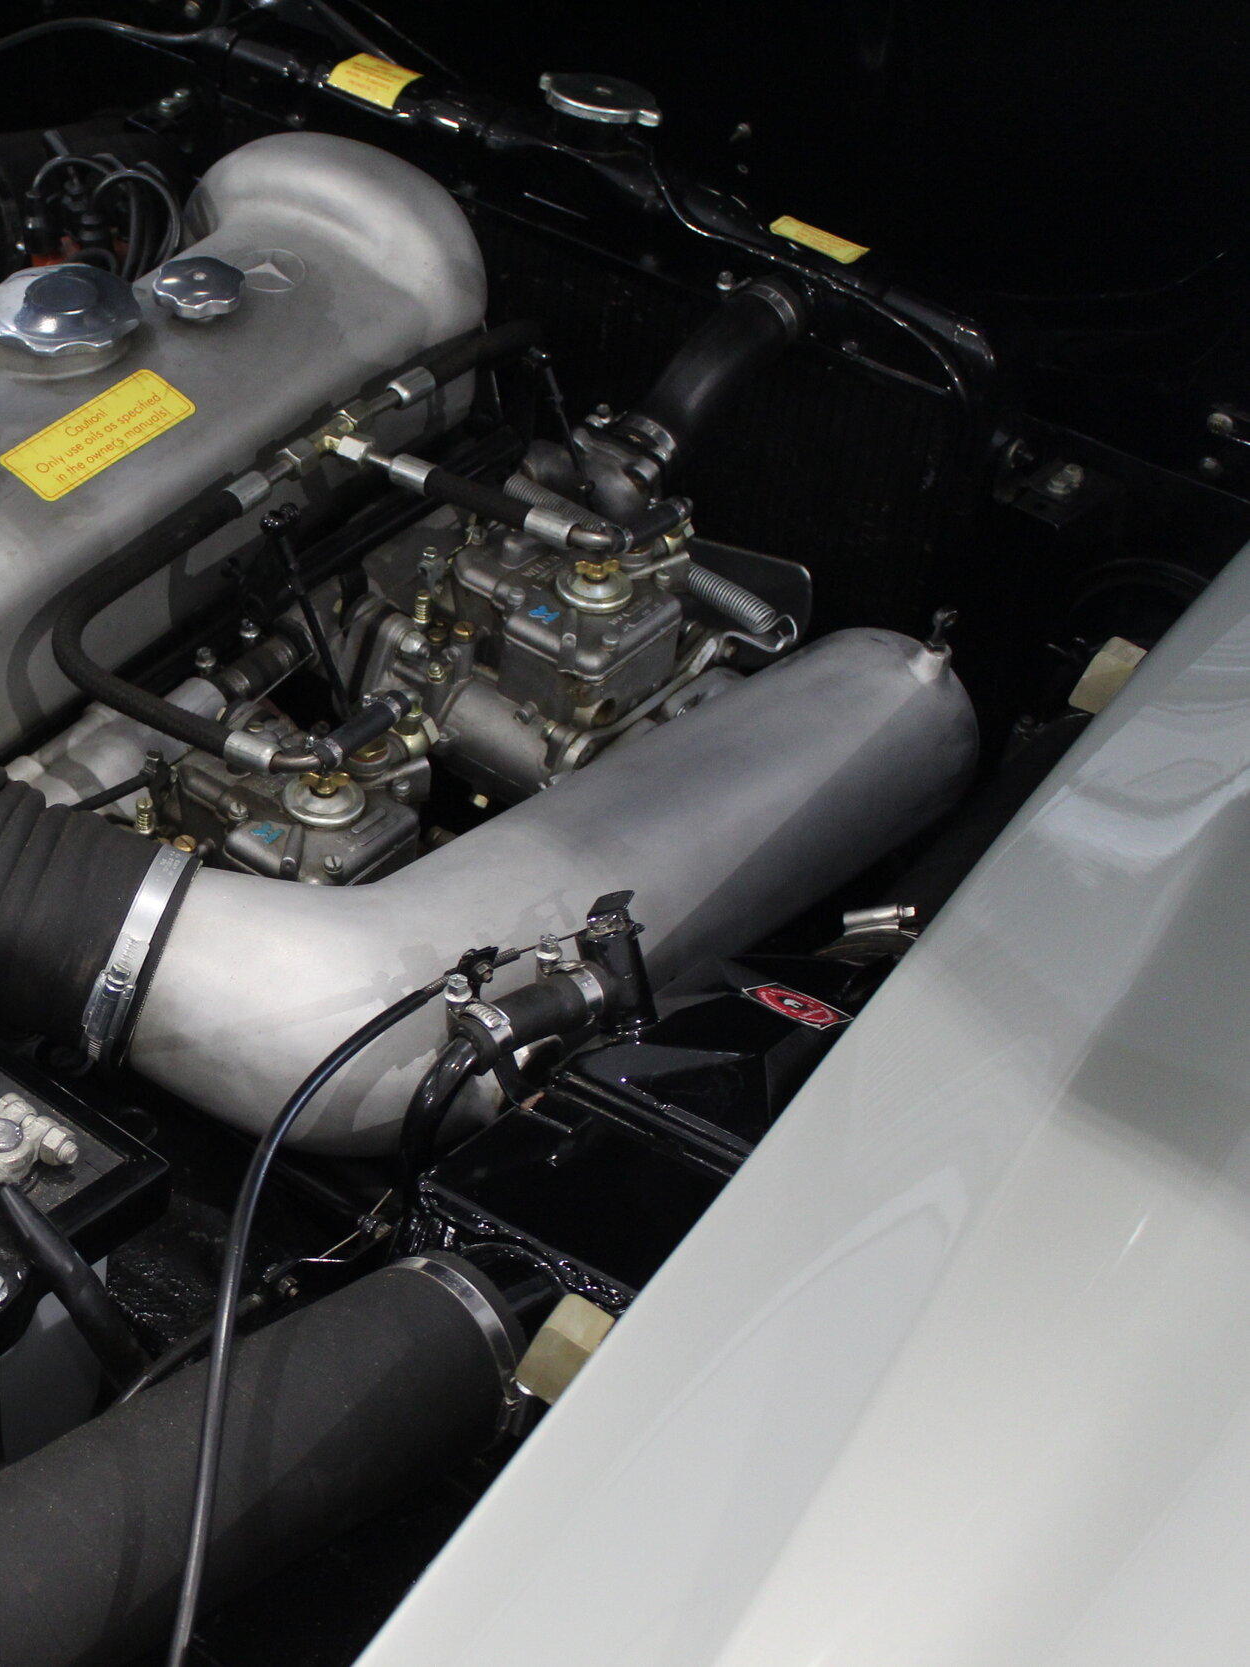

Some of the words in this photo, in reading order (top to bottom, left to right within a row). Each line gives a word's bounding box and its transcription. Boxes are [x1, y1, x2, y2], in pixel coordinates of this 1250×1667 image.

[36, 454, 65, 474] Only
[65, 444, 84, 459] use
[85, 431, 103, 446] oils
[104, 422, 118, 433] as
[118, 391, 161, 425] specified
[55, 471, 67, 484] in
[66, 460, 85, 476] the
[124, 407, 170, 440] manuals!
[65, 408, 108, 437] Caution!
